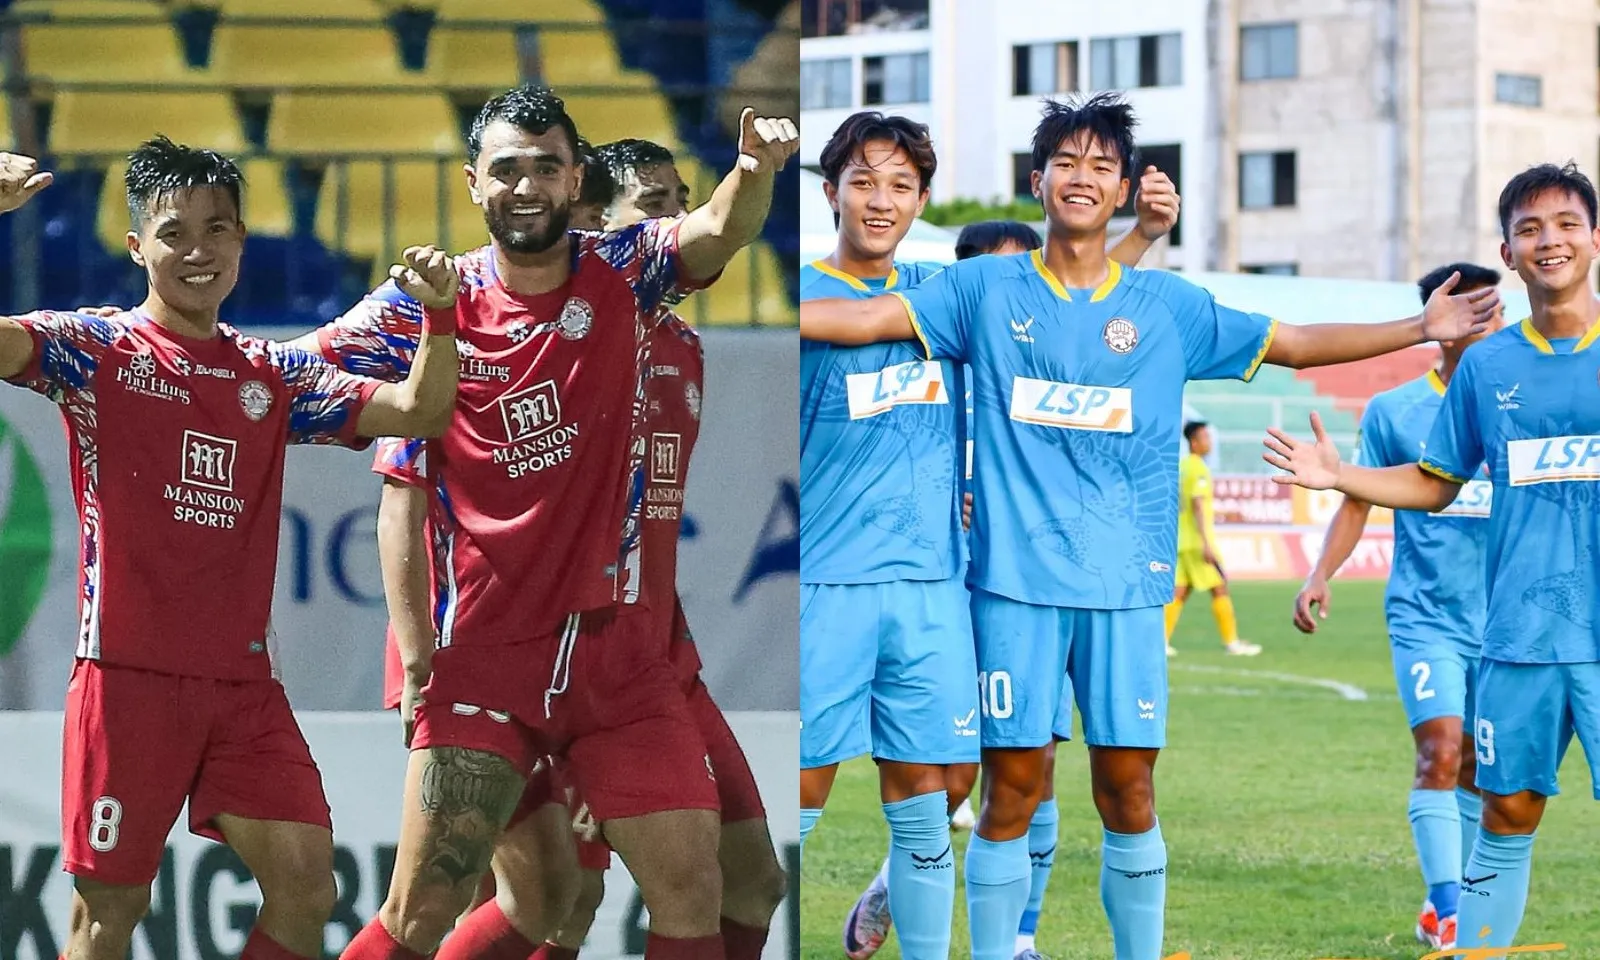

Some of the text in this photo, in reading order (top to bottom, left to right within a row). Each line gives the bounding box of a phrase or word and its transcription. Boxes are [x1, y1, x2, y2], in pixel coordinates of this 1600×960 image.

[470, 359, 511, 382] Hung
[150, 377, 191, 405] Hung
[1035, 384, 1111, 416] LSP
[492, 422, 579, 464] MANSION
[507, 444, 572, 479] SPORTS
[163, 483, 244, 513] MANSION
[645, 505, 678, 520] SPORTS
[173, 505, 236, 529] SPORTS
[978, 671, 1013, 719] 10
[1410, 661, 1436, 702] 2
[88, 796, 122, 852] 8
